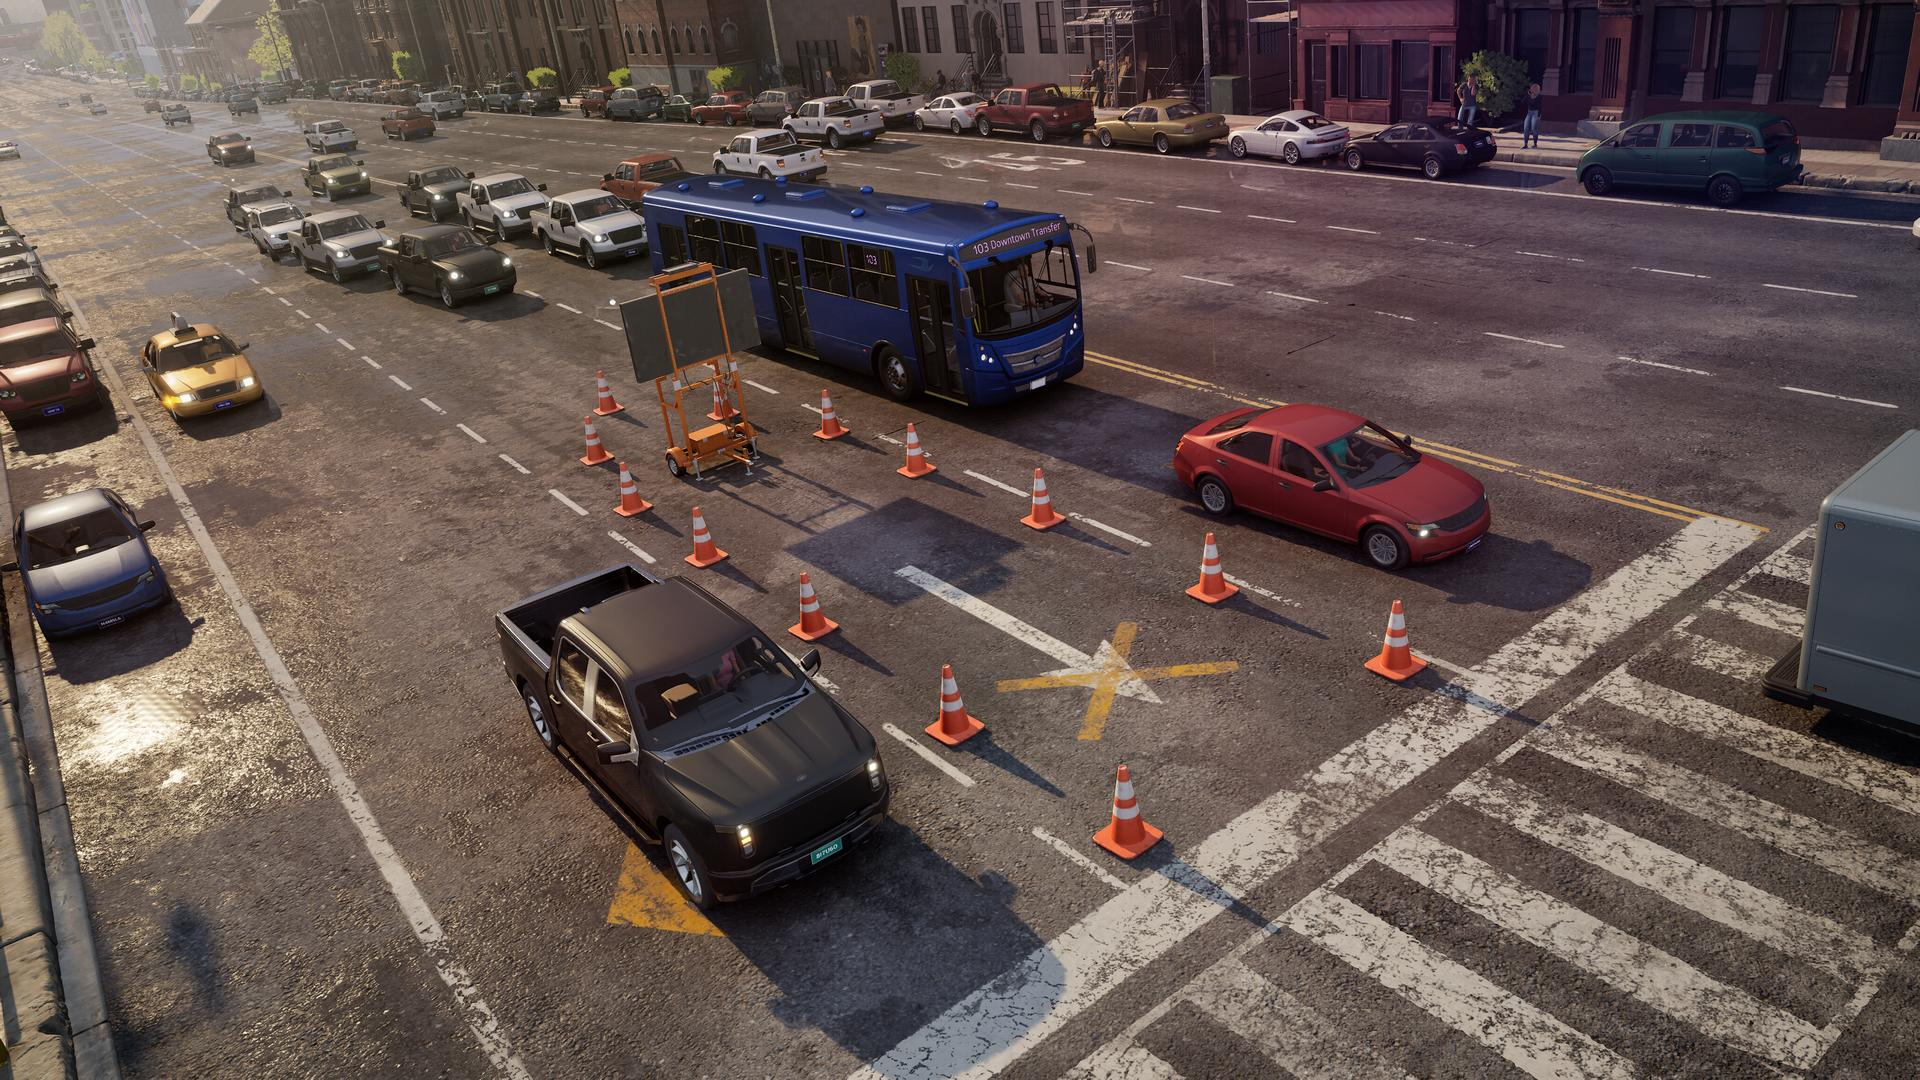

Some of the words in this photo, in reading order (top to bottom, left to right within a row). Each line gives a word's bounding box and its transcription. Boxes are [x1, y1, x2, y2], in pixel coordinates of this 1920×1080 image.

[973, 242, 990, 255] 103
[990, 232, 1031, 250] Downtown
[1031, 222, 1061, 238] Transfer
[866, 254, 878, 265] 103
